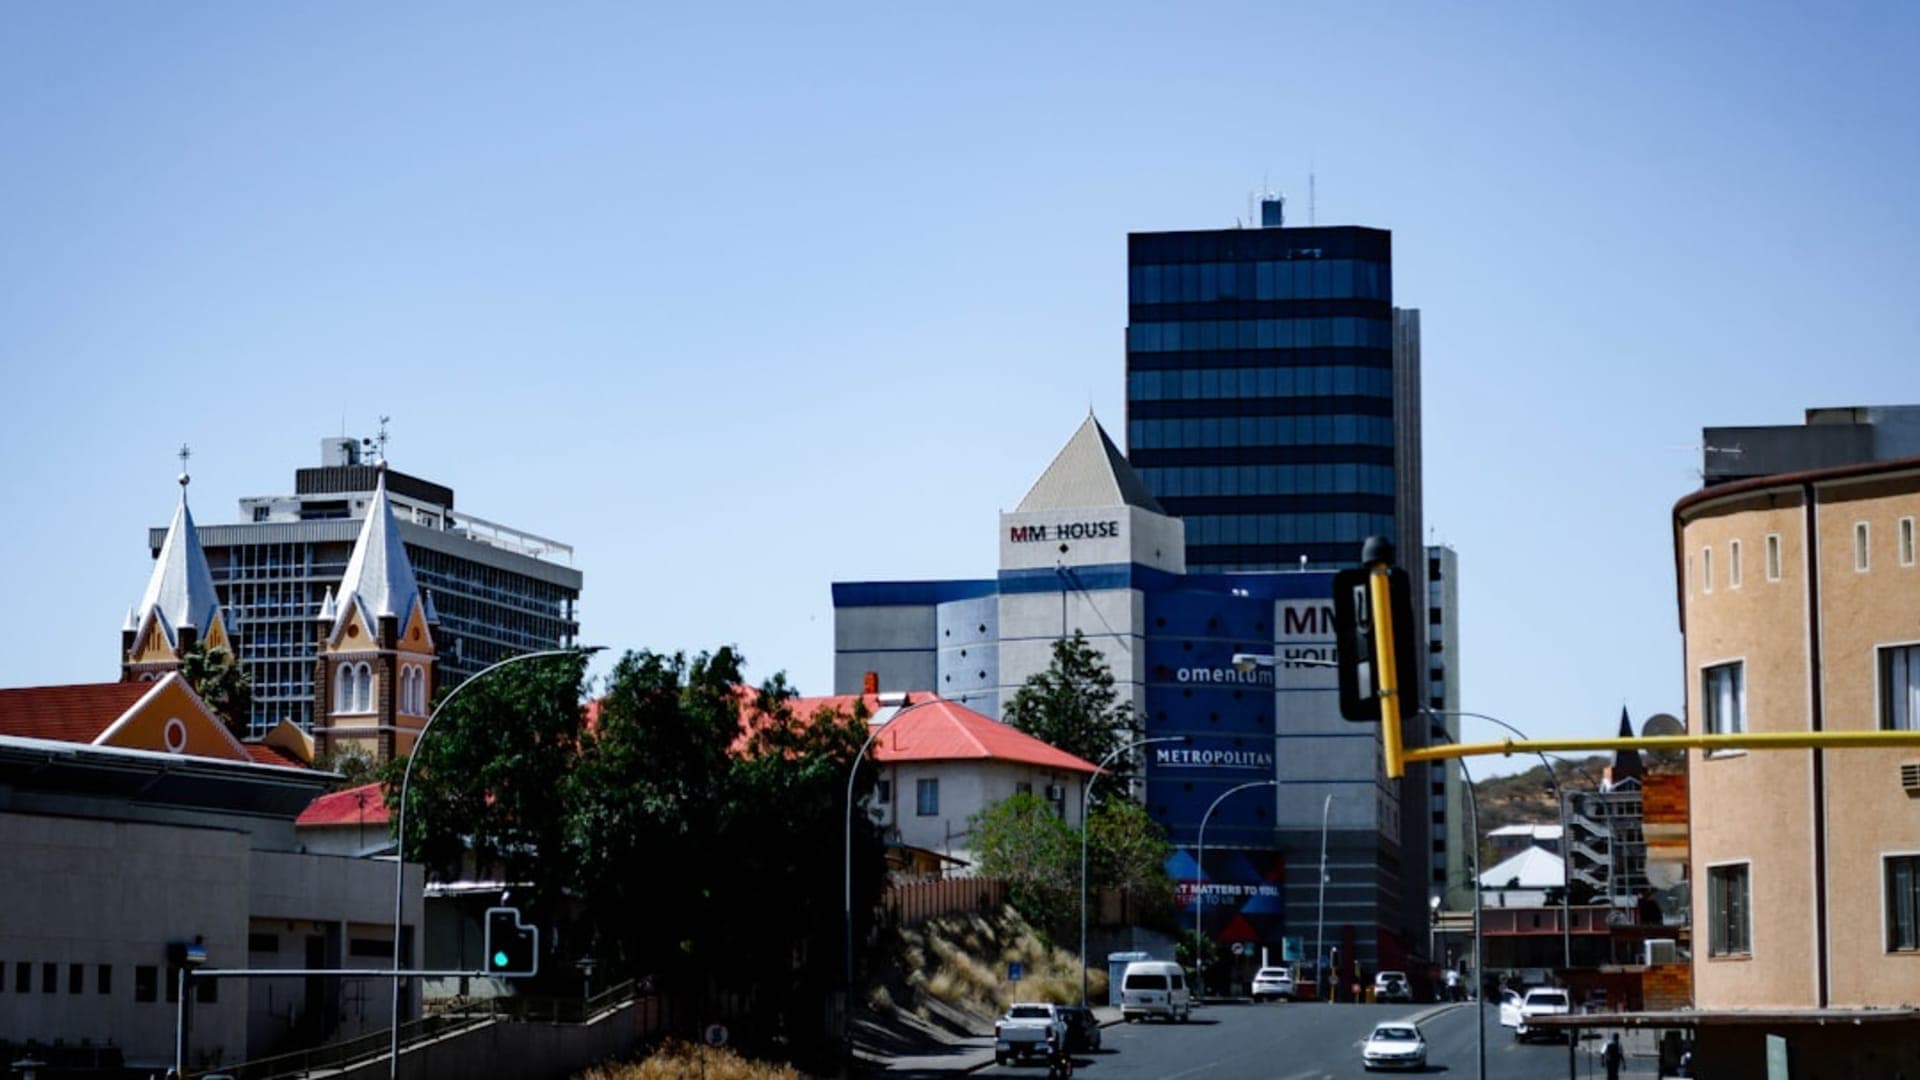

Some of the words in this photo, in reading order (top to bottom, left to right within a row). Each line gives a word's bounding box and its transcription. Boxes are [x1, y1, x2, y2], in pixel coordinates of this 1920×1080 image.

[1010, 525, 1046, 542] MM
[1057, 521, 1119, 540] HOUSE
[1284, 648, 1337, 668] HOU
[1155, 667, 1273, 684] omentum
[1156, 749, 1272, 766] METROPOLITAN
[1190, 884, 1241, 895] MATTERS
[1244, 885, 1258, 896] TO
